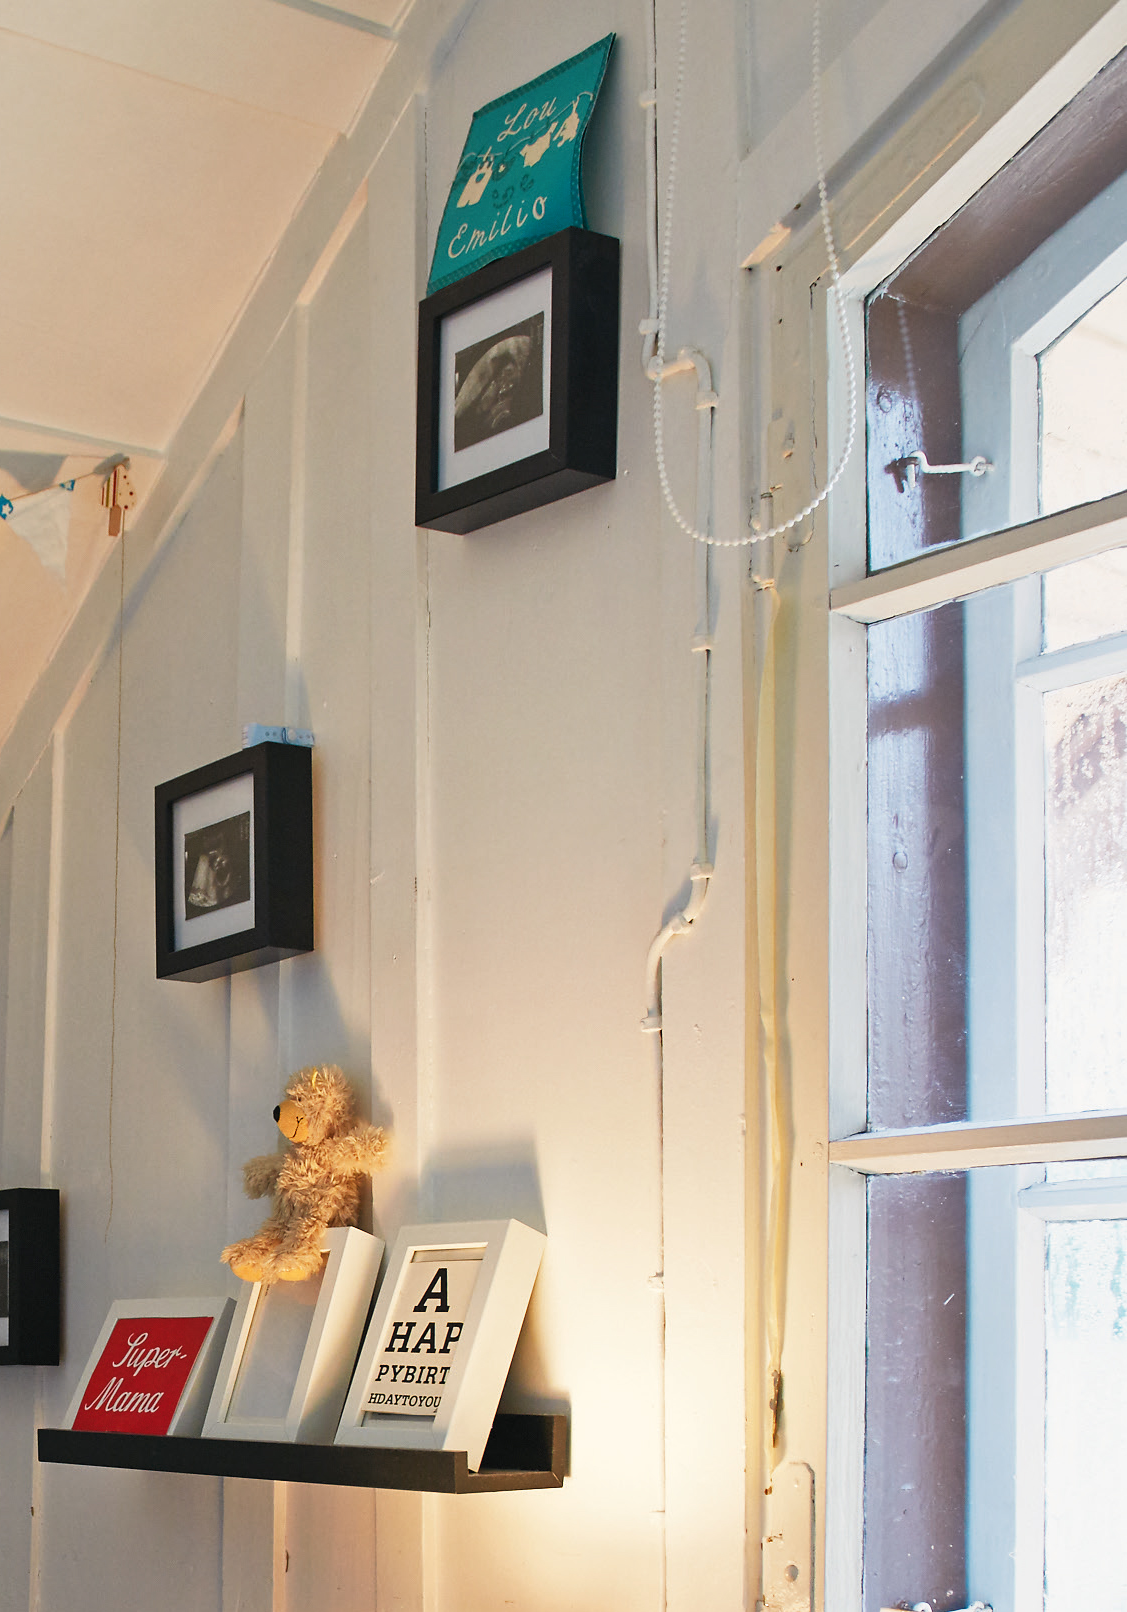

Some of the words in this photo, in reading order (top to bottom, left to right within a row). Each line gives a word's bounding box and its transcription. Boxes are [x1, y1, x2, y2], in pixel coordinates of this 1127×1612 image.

[497, 97, 557, 142] Lou
[448, 196, 547, 258] Emilio
[413, 1268, 450, 1312] A
[384, 1322, 464, 1354] HAP
[375, 1365, 450, 1384] PYBIRT
[84, 1377, 164, 1413] Mama
[368, 1393, 442, 1408] HDAYTOYOU
